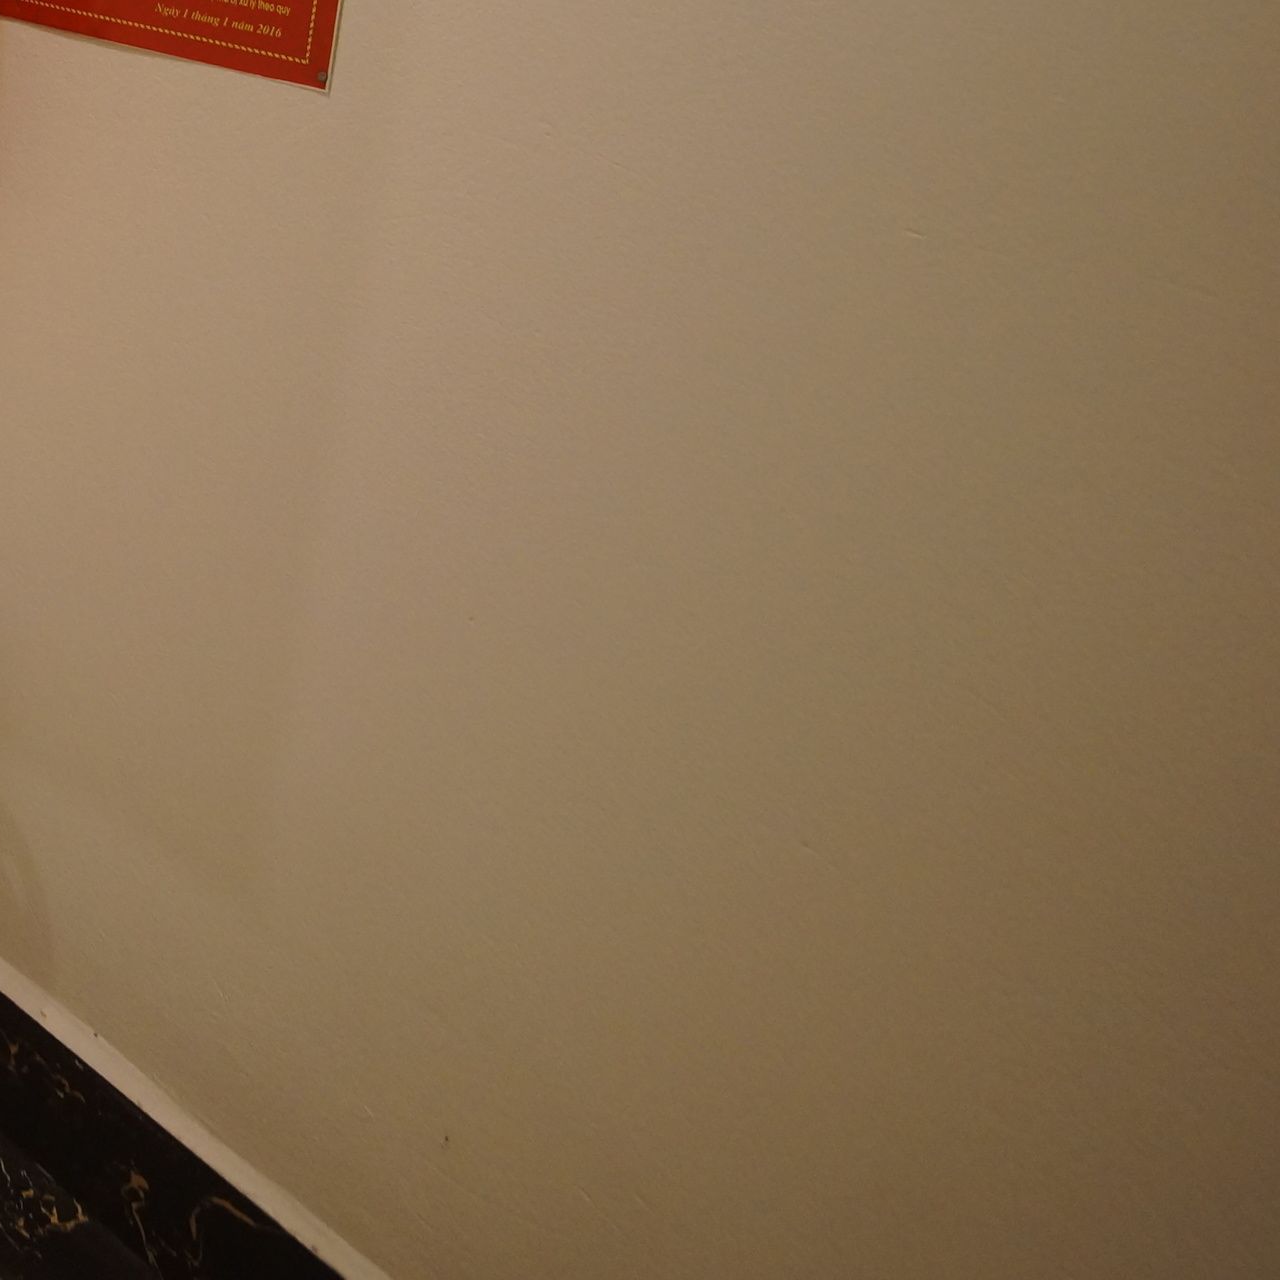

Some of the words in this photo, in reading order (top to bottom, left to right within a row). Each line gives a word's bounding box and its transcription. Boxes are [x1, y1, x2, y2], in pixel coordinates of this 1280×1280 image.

[154, 2, 179, 18] Ngày
[190, 10, 221, 27] tháng
[231, 21, 254, 32] năm
[256, 23, 282, 38] 2016
